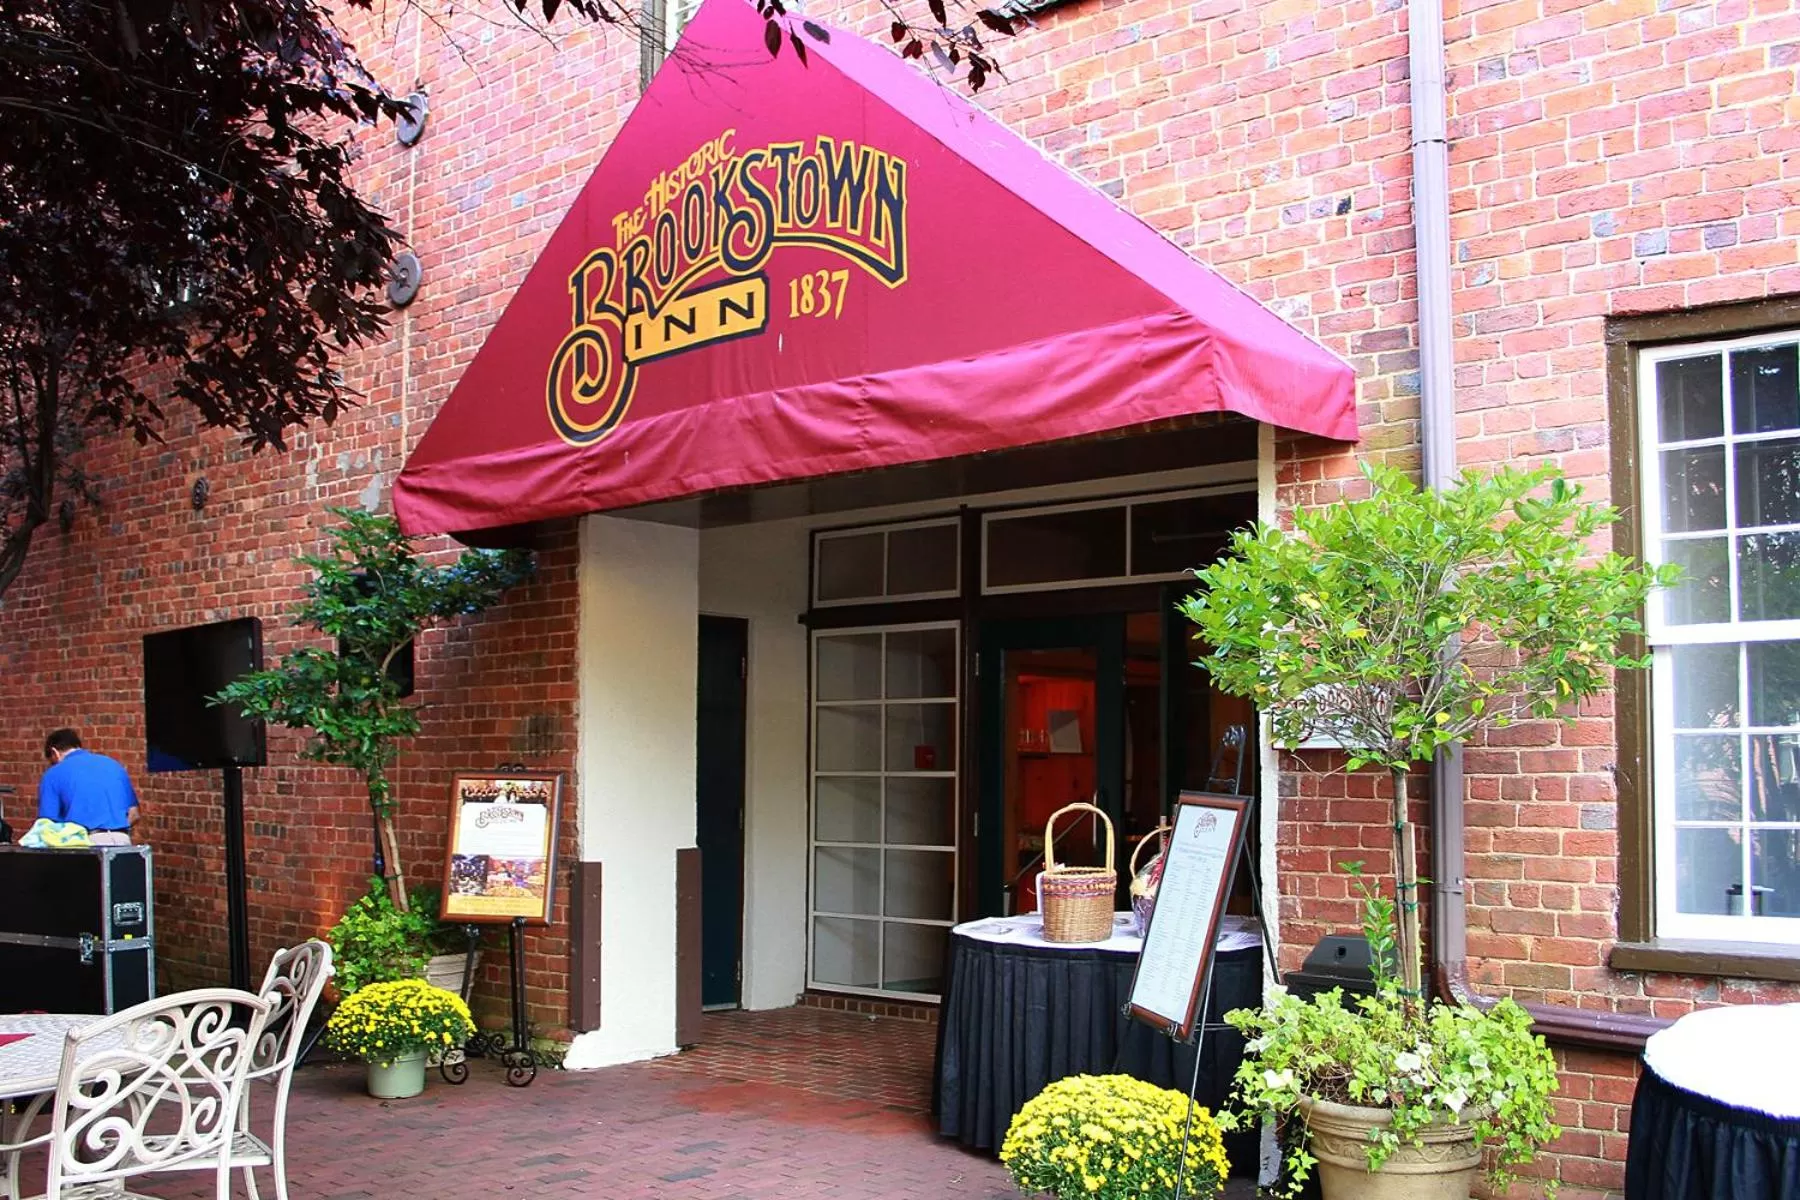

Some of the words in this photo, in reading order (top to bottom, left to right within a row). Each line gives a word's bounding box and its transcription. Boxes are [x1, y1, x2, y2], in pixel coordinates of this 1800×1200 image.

[643, 128, 737, 220] HISTORIC
[546, 134, 908, 447] BROOKSTOWN
[633, 292, 755, 350] INN
[787, 268, 850, 320] 1837
